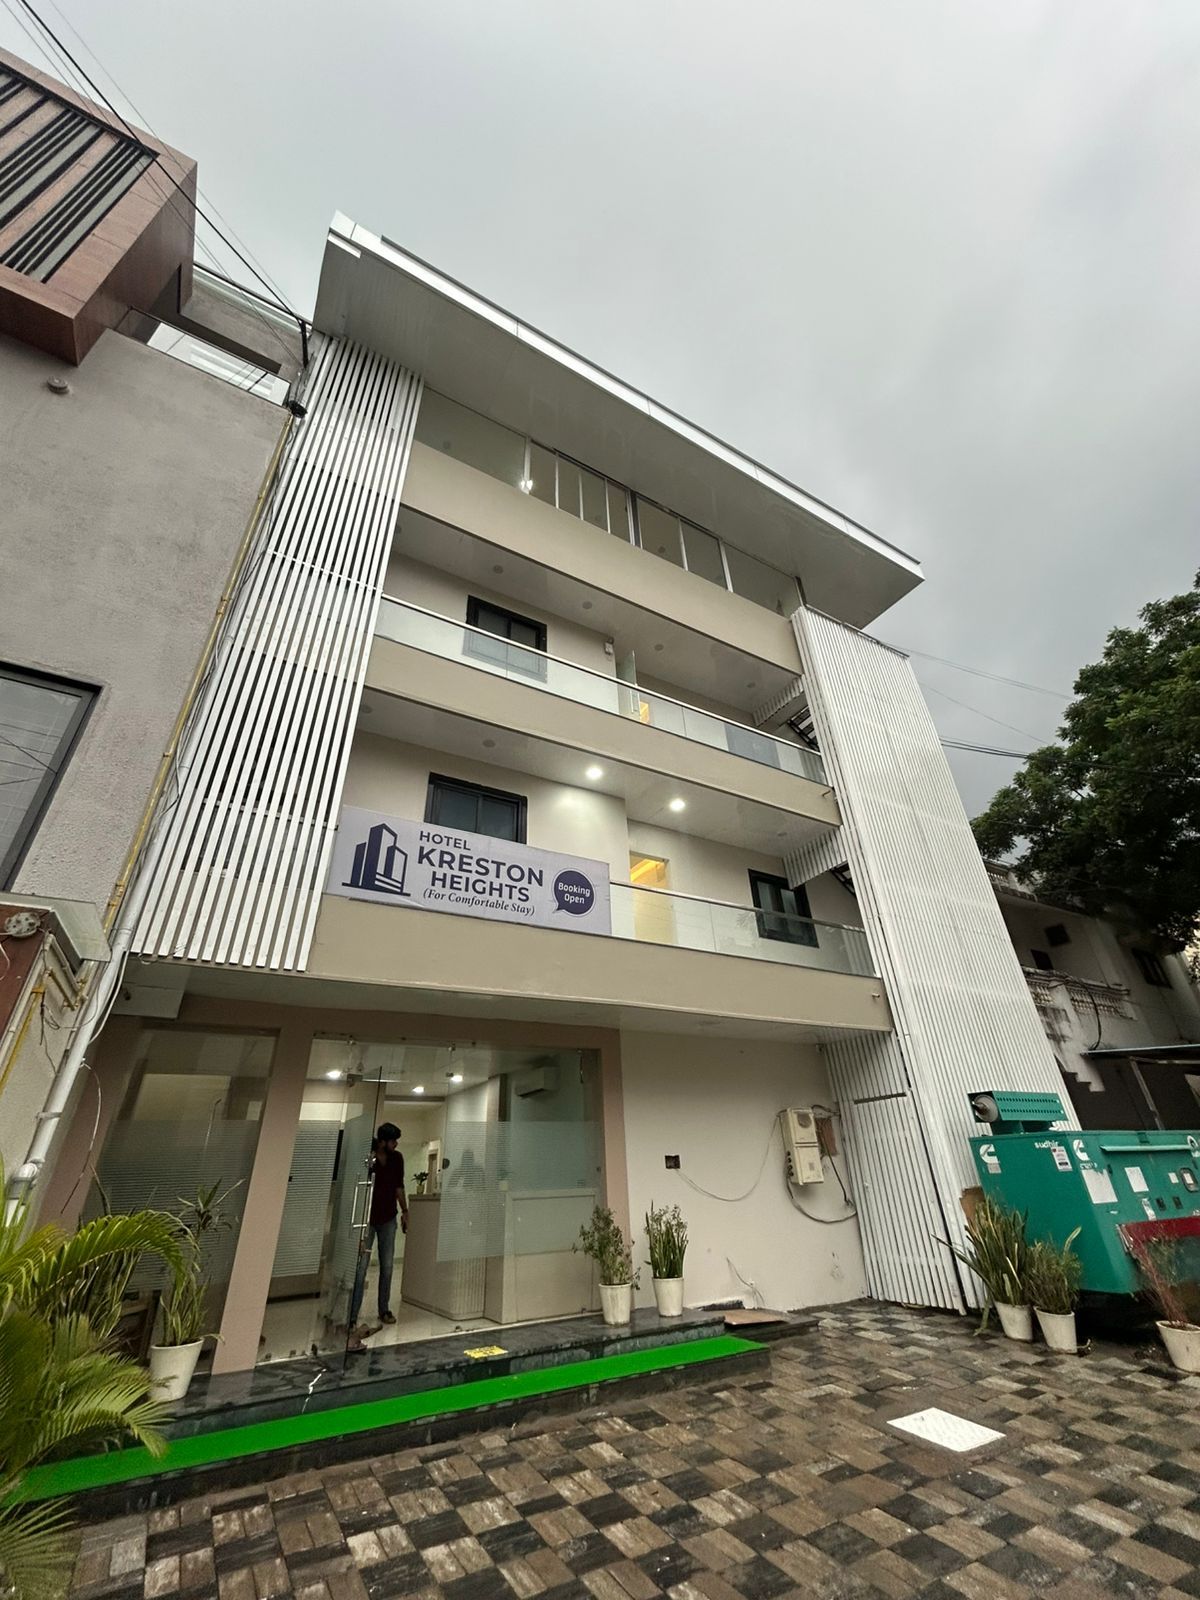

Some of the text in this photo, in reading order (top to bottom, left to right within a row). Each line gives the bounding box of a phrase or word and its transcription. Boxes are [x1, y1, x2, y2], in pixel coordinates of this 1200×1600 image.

[419, 830, 471, 851] HOTEL
[417, 845, 544, 887] KRESTON
[430, 870, 530, 902] HEIGHTS
[558, 882, 590, 897] Booking
[564, 893, 585, 904] Open
[423, 887, 535, 917] (For Comfortable Stay)
